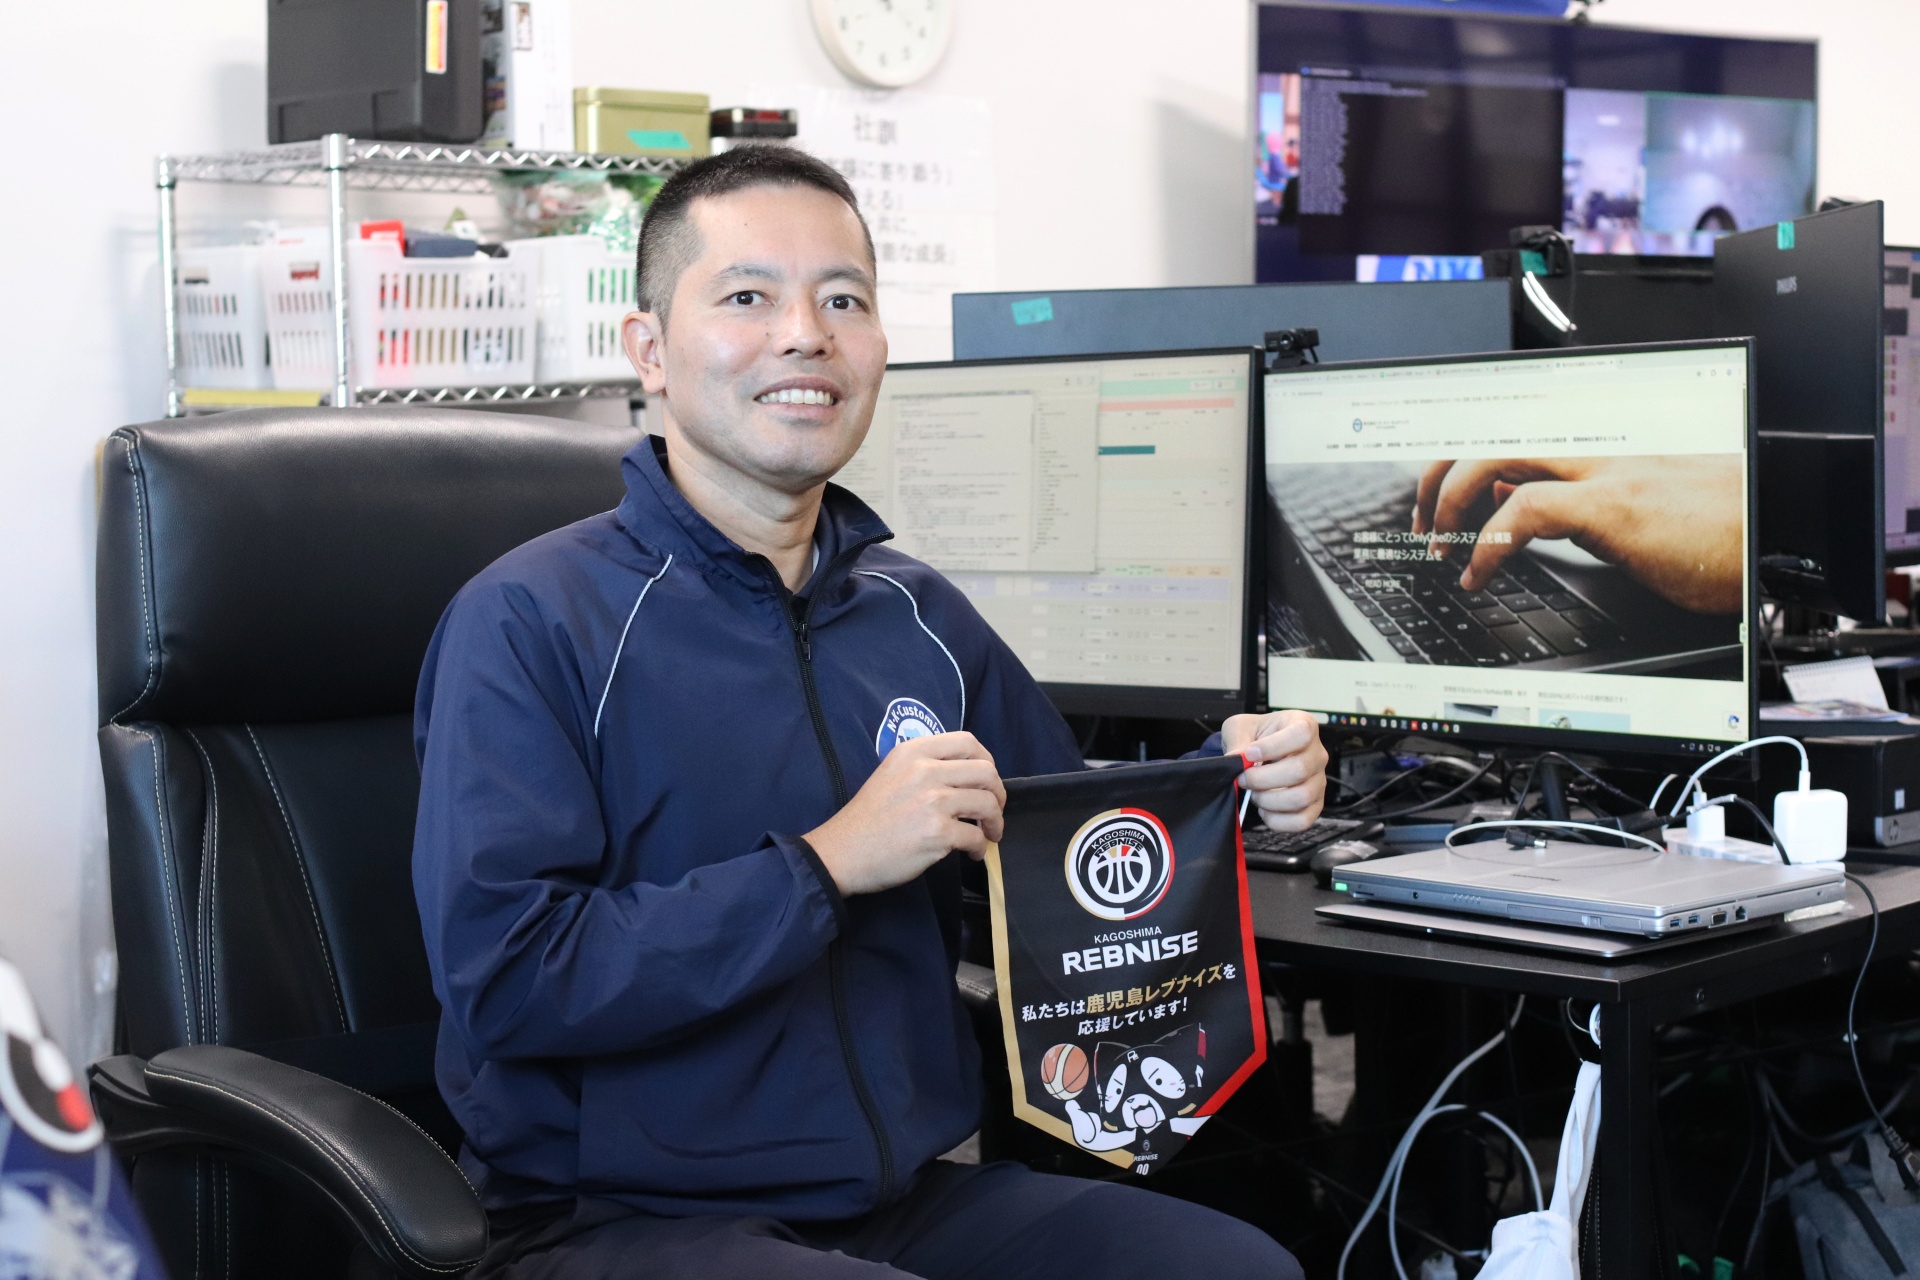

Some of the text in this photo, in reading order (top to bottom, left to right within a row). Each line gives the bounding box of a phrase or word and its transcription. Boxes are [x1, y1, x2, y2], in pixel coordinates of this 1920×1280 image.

[1091, 829, 1145, 850] KAGOSHIMA
[1094, 837, 1144, 858] REBNISE
[1094, 925, 1162, 944] KAGOSHIMA
[1062, 930, 1199, 976] REBNISE
[1021, 962, 1237, 1022] 私たちは鹿児島レブナイズを
[1077, 996, 1188, 1036] 応援しています!
